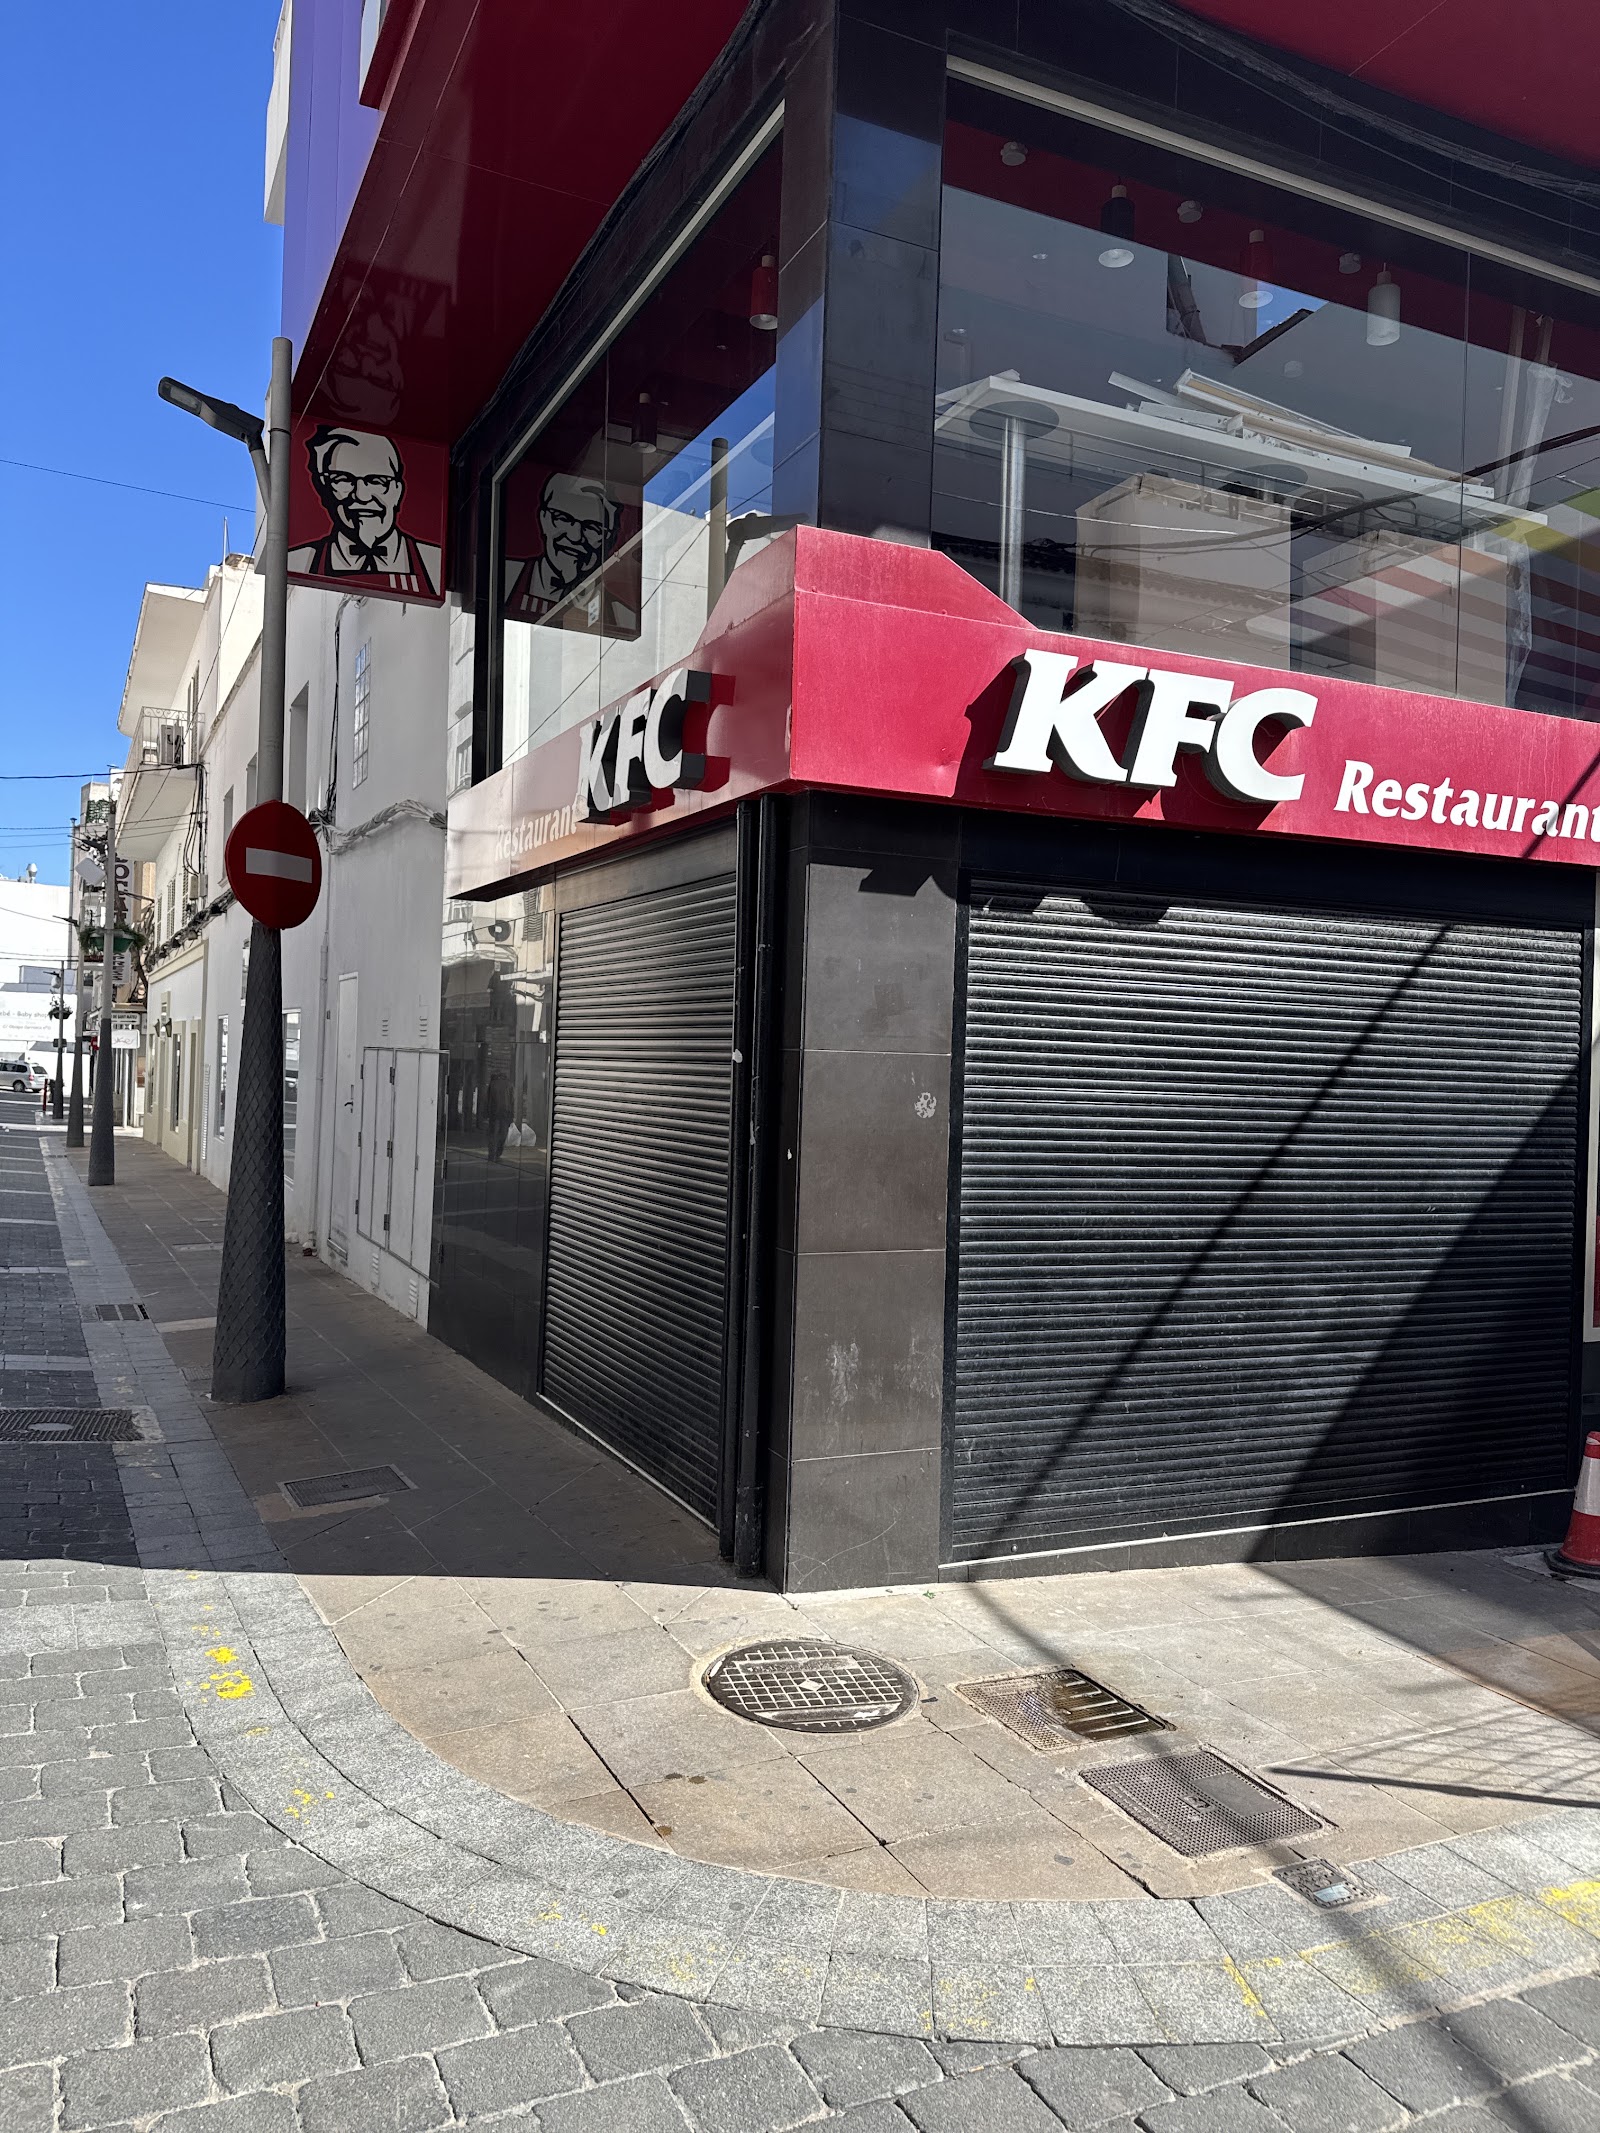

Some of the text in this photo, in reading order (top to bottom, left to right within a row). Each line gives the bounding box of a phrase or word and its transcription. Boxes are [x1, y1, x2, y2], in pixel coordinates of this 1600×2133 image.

[576, 668, 690, 821] KFC
[993, 648, 1319, 803] KFC
[495, 801, 578, 861] Restaurant
